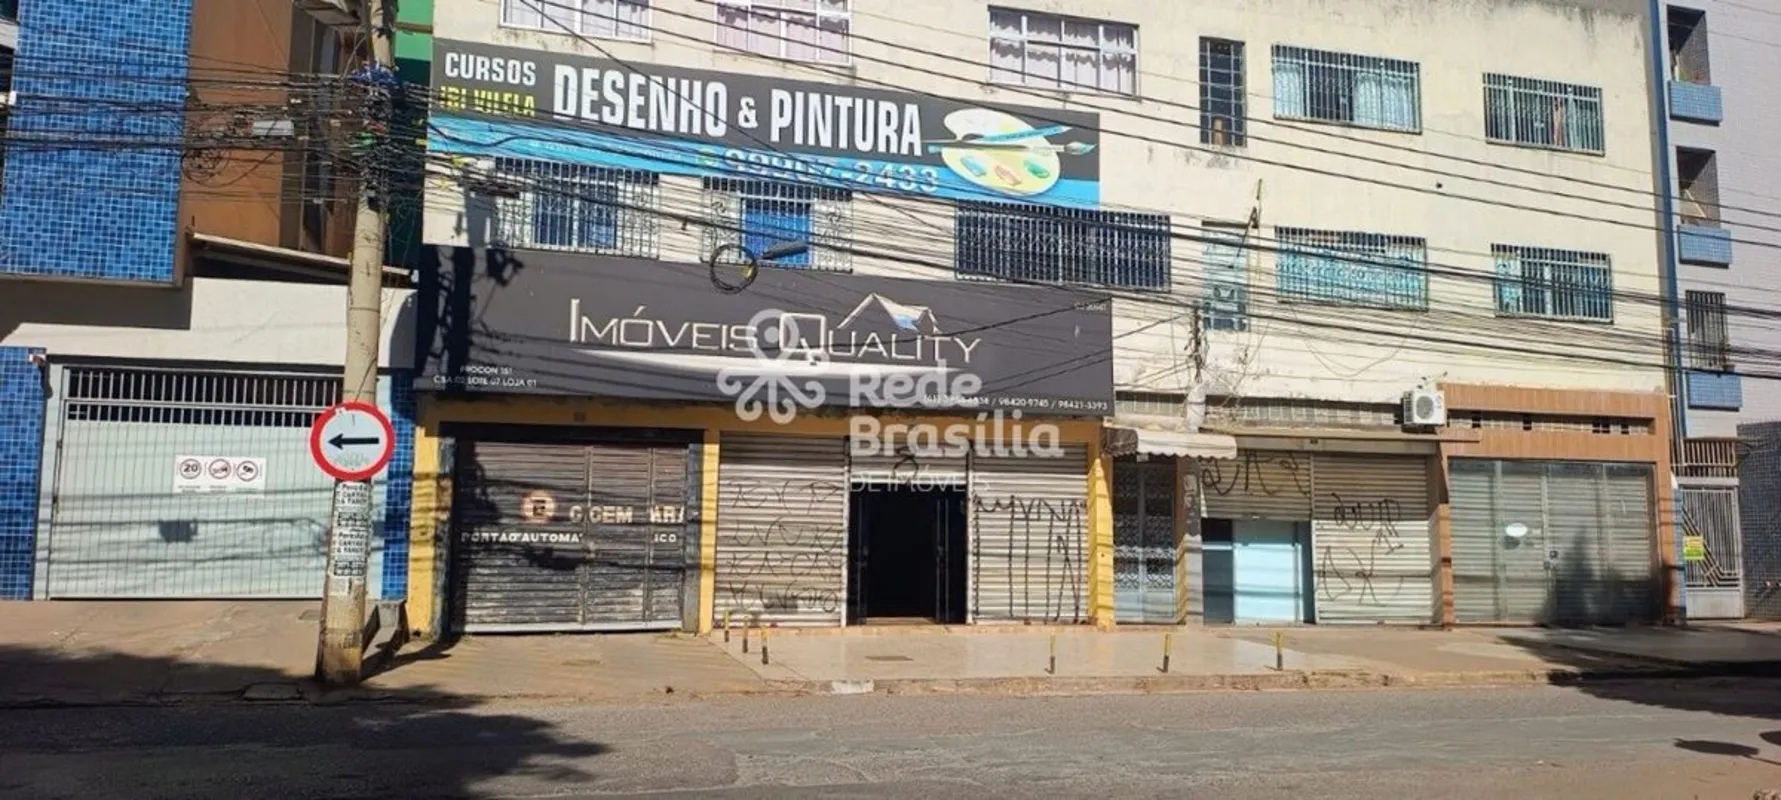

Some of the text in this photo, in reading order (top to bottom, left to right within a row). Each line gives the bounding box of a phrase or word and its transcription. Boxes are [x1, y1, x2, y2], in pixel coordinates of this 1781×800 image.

[444, 52, 537, 86] CURSOS
[553, 64, 922, 157] DESENHO & PINTURA
[569, 298, 982, 366] IMÓVEIS QUALITY
[183, 463, 198, 473] 20
